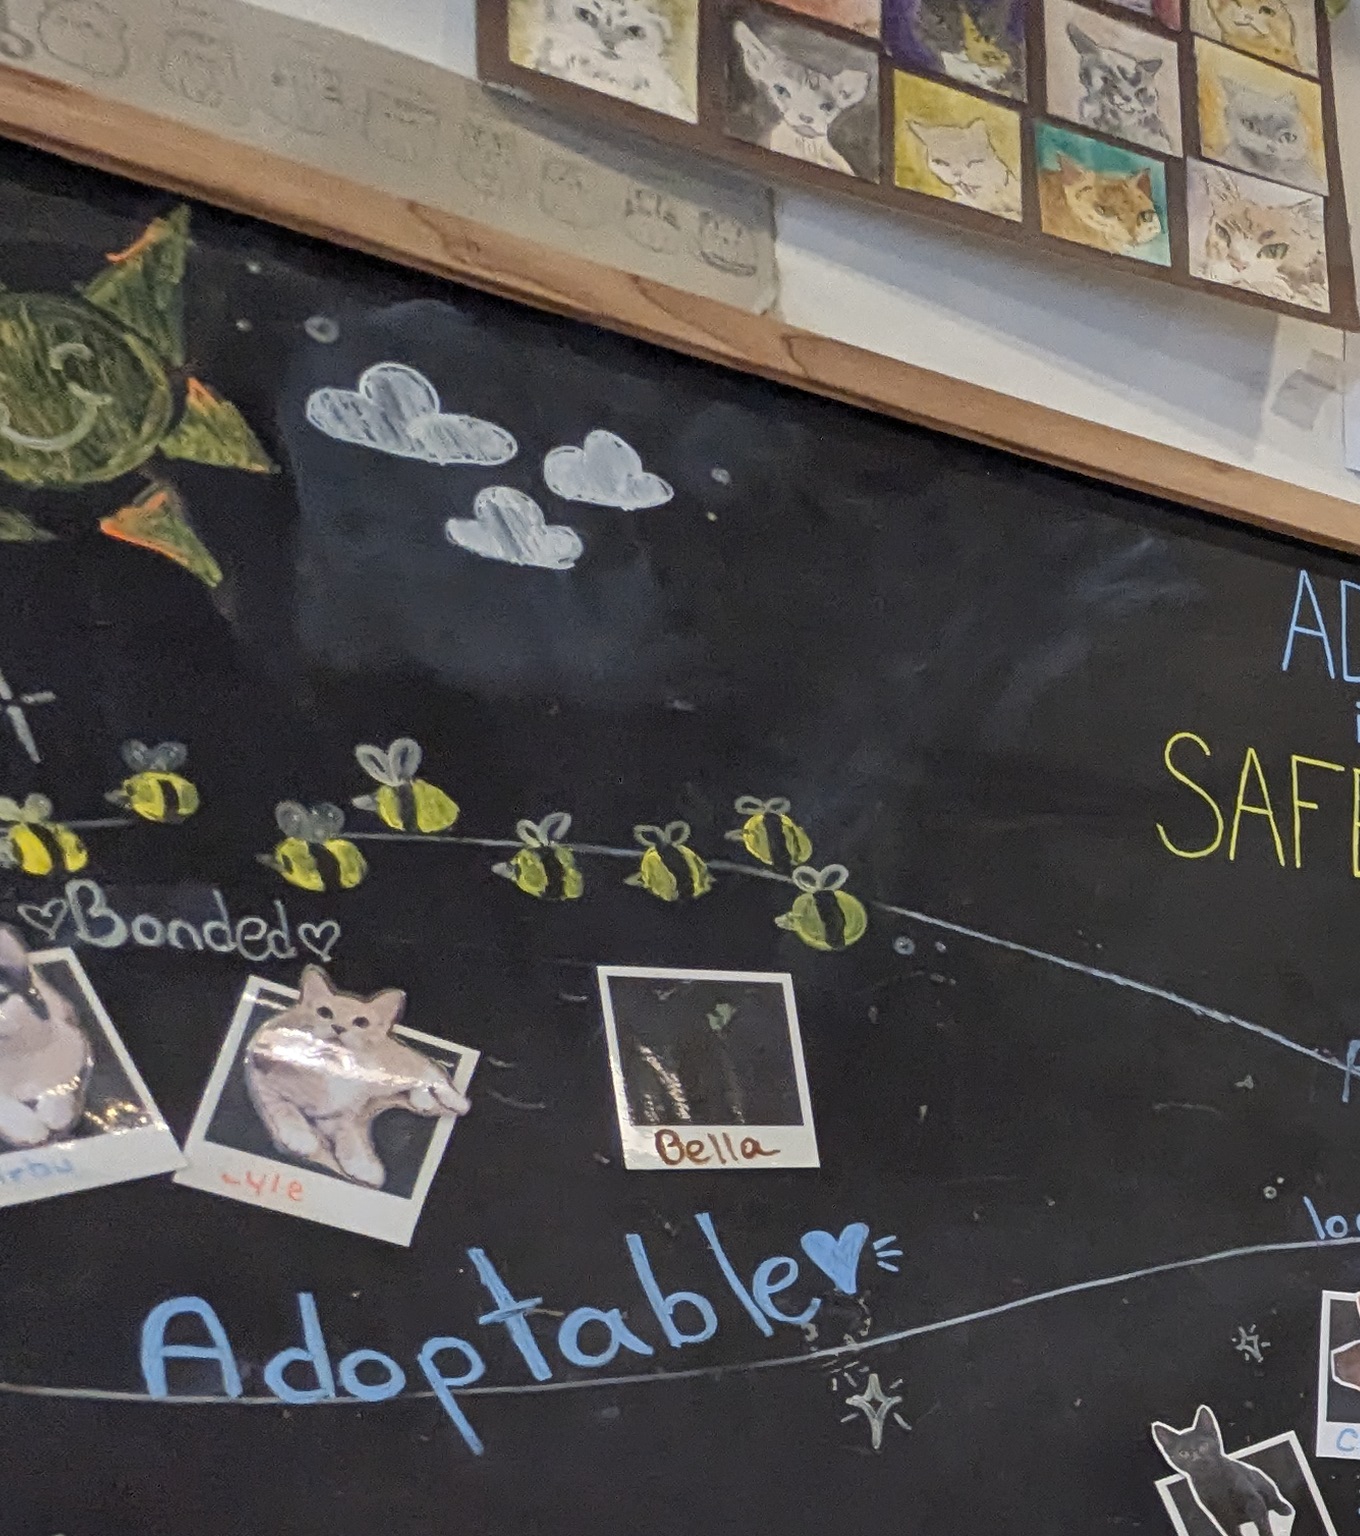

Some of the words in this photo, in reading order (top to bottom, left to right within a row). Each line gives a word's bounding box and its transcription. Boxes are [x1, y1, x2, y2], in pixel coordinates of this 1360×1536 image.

[65, 879, 293, 962] Bonded
[653, 1126, 781, 1166] Bella
[141, 1212, 822, 1456] Adoptable
